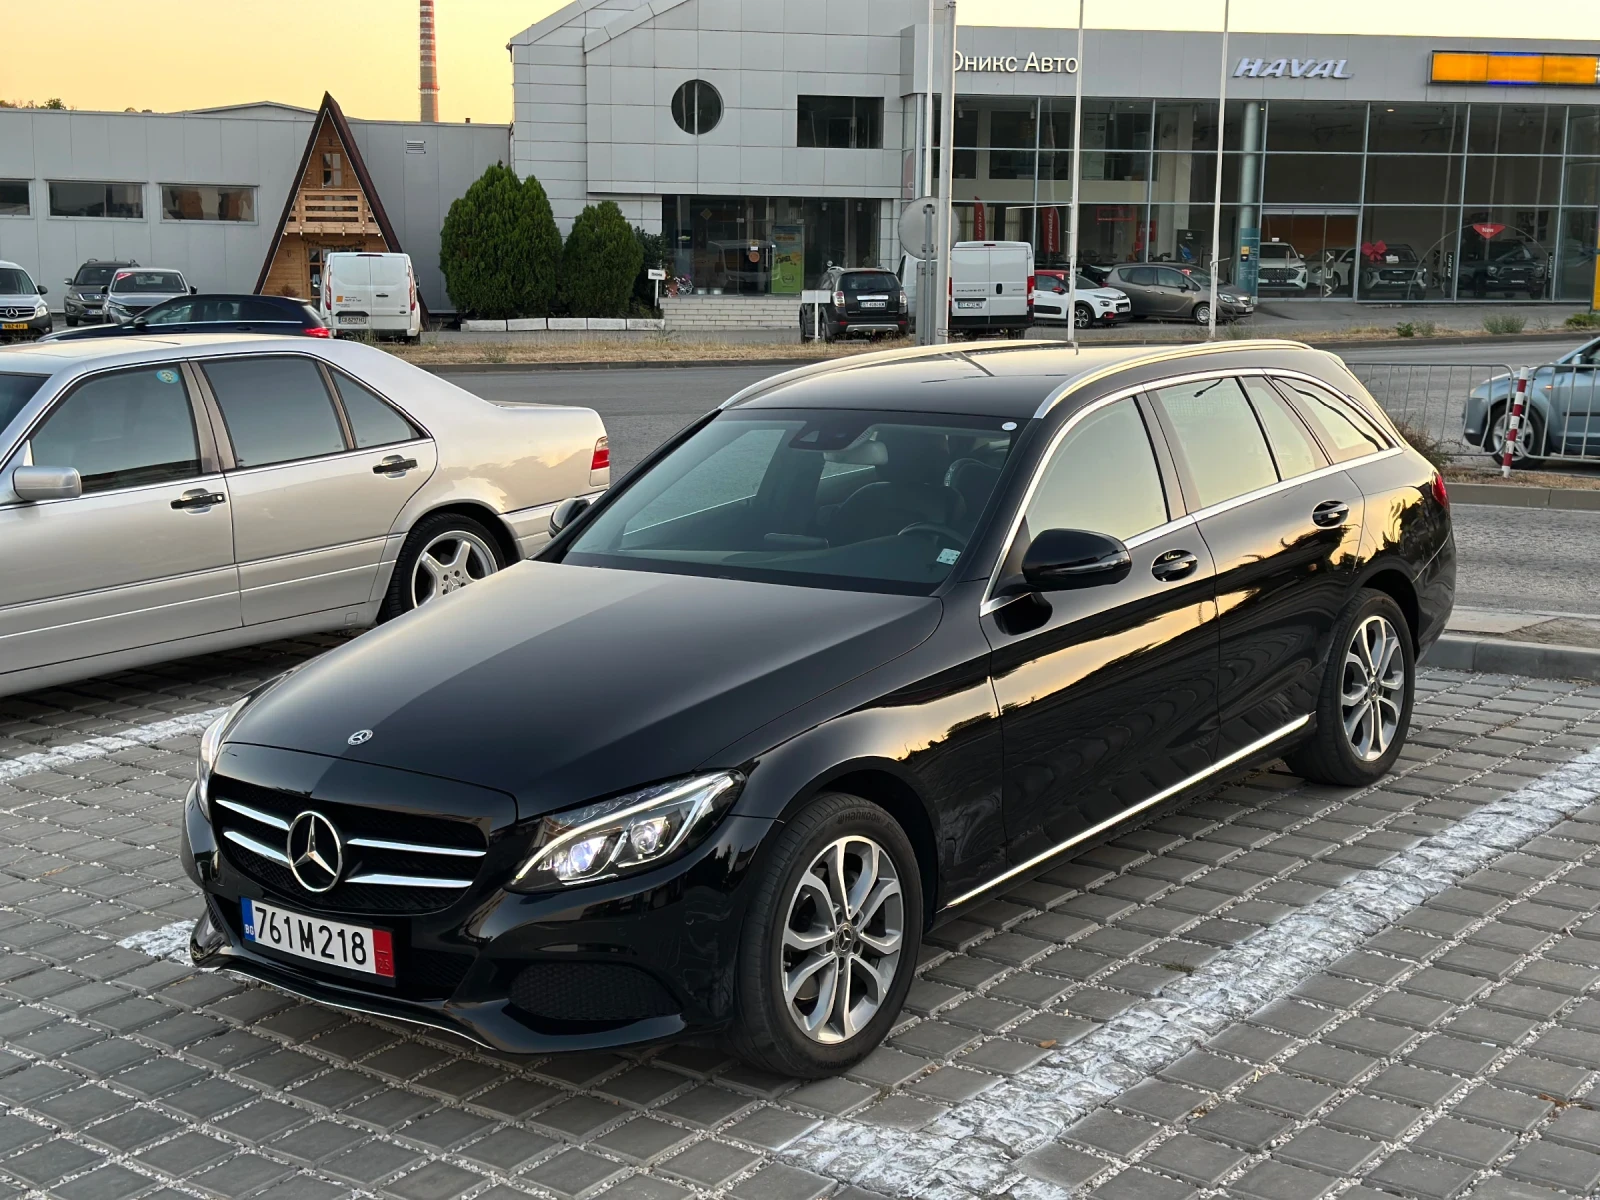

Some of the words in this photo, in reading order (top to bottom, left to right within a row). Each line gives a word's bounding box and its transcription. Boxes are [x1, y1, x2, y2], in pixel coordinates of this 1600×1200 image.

[1023, 51, 1079, 73] Авто
[1232, 58, 1355, 79] HAVAL
[244, 924, 255, 936] BG
